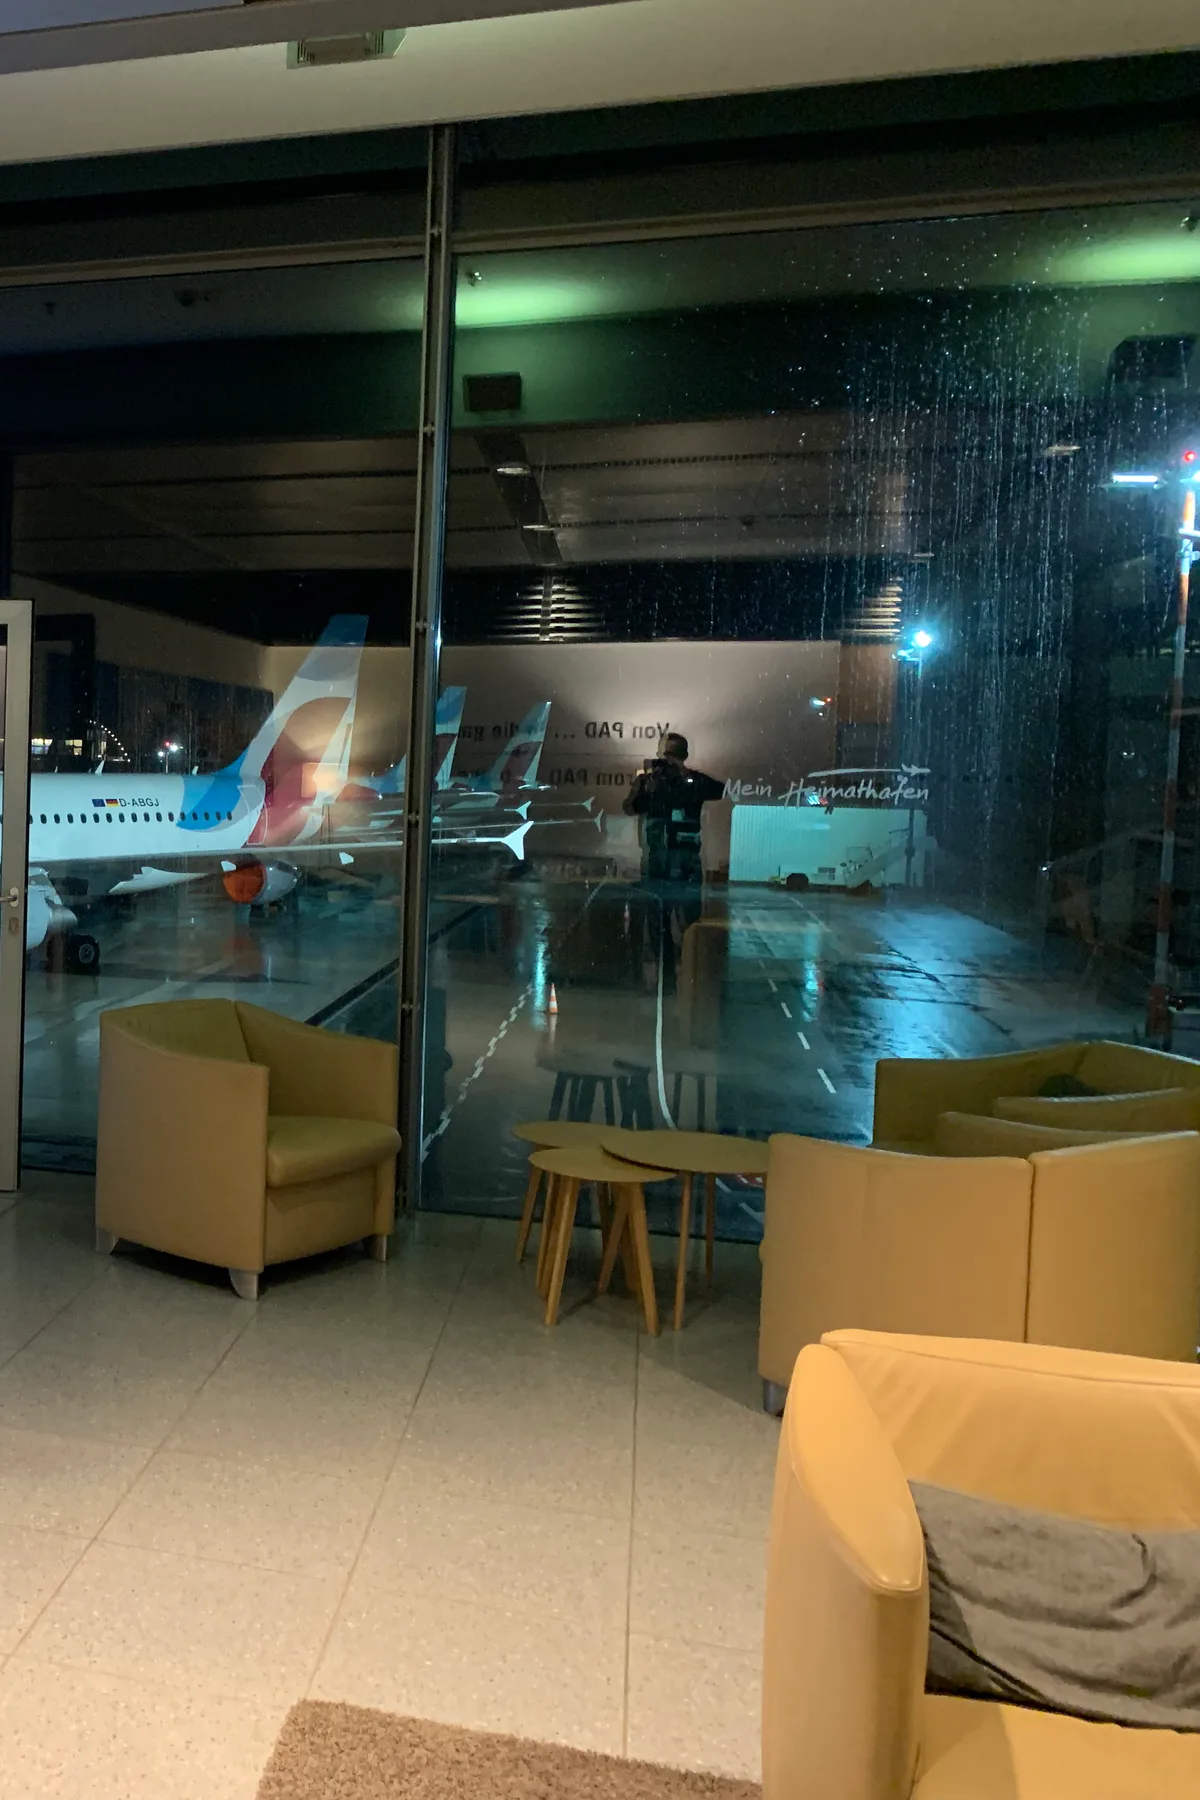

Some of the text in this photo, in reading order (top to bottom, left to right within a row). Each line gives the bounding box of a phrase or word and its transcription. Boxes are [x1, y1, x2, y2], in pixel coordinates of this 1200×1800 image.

[721, 774, 929, 808] Mein Heimathafen
[119, 798, 159, 807] D-ABGJ
